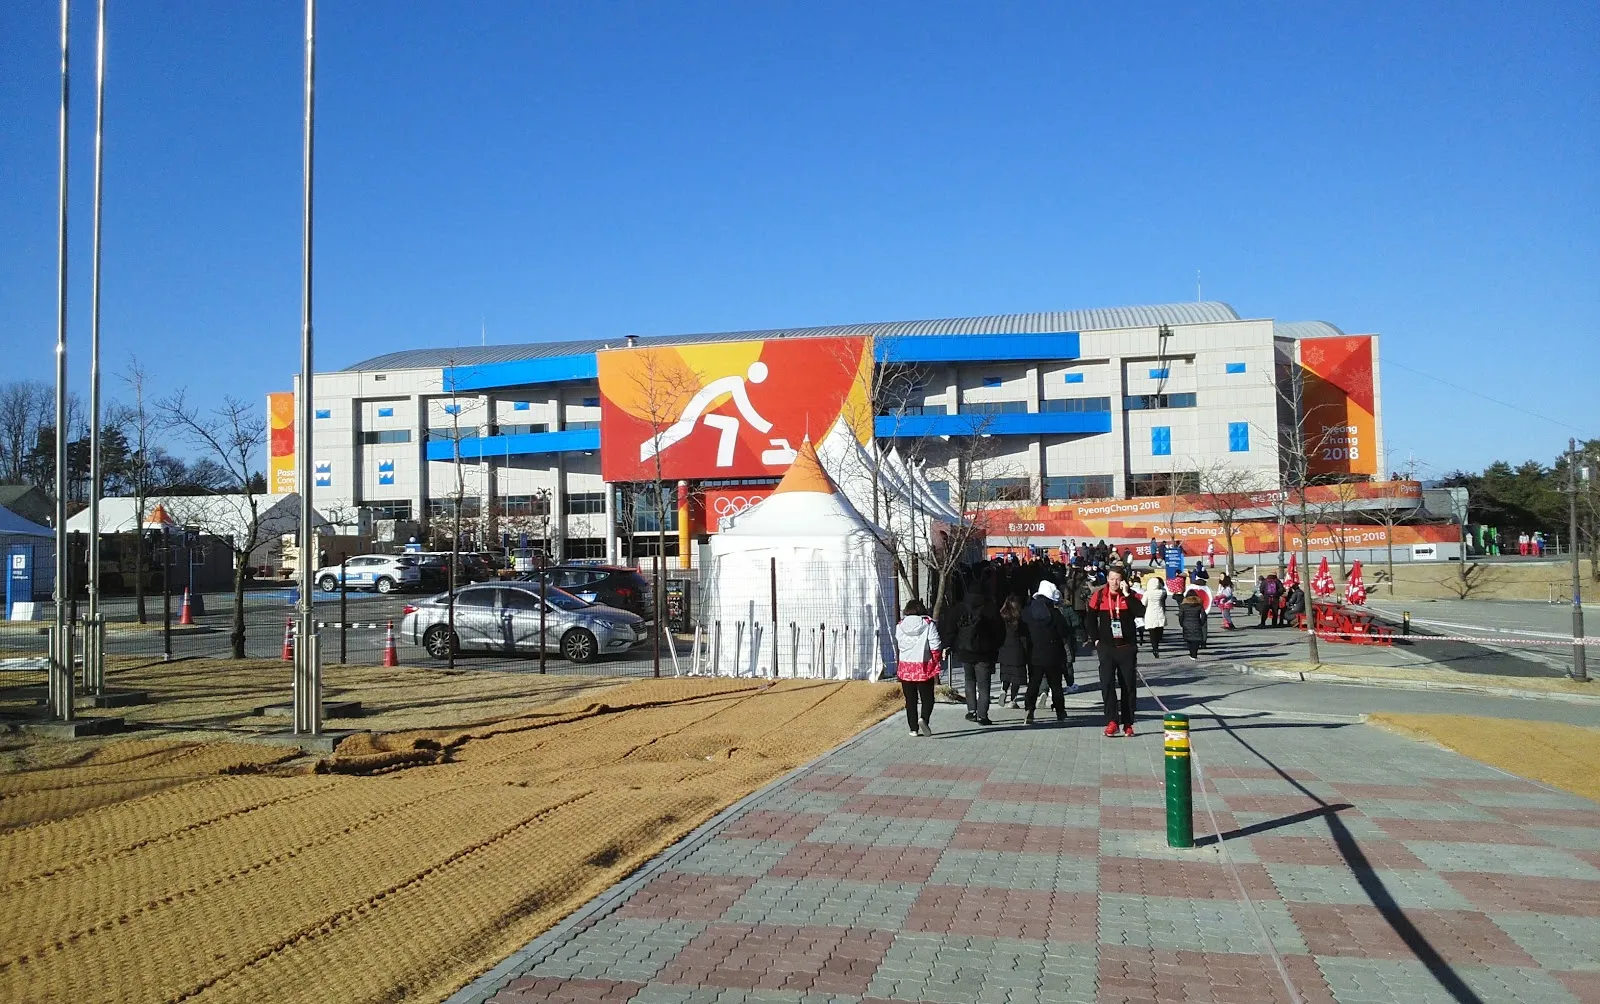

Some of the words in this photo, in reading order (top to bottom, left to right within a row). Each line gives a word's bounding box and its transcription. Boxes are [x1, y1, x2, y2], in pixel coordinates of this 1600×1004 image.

[1321, 425, 1358, 435] Pyeong
[1322, 447, 1359, 460] 2018
[1078, 503, 1138, 516] PyeongChang
[1139, 501, 1160, 511] 2018
[1024, 523, 1045, 532] 2018
[1362, 531, 1387, 542] 2018
